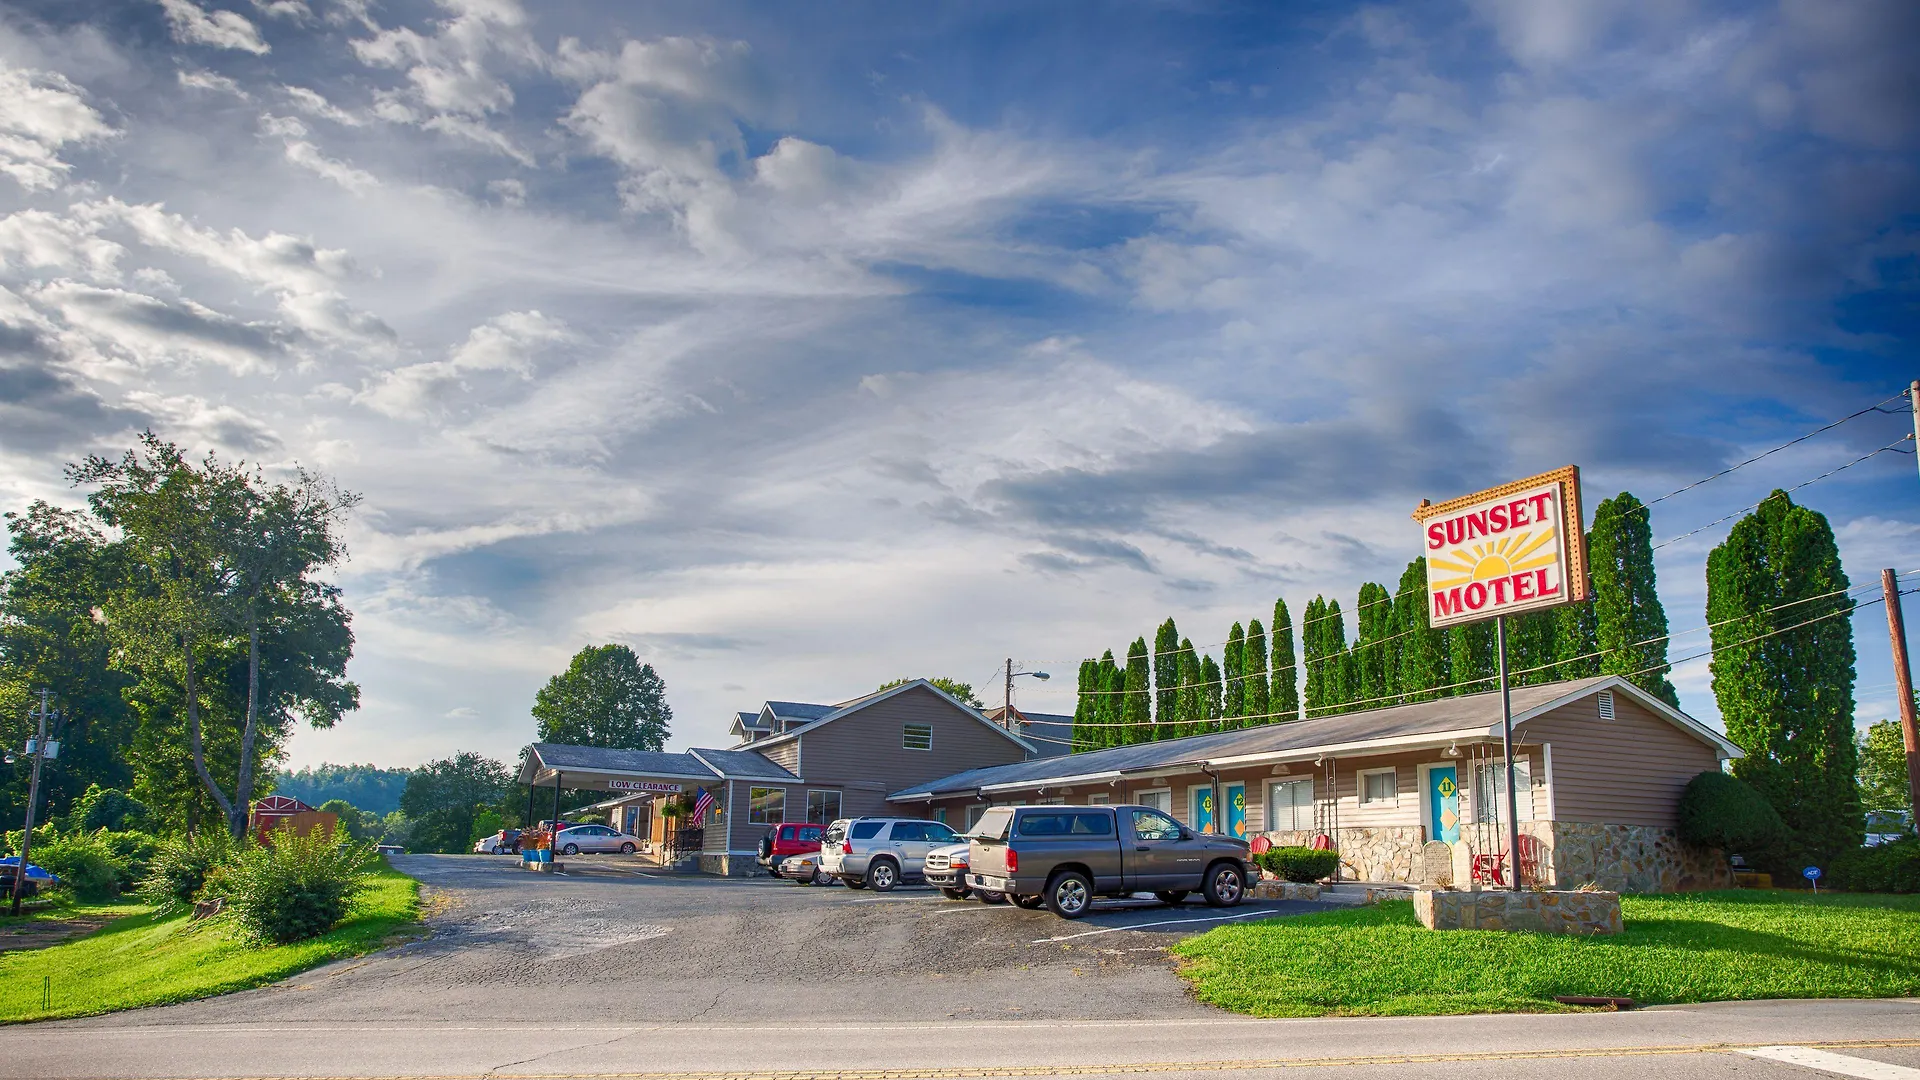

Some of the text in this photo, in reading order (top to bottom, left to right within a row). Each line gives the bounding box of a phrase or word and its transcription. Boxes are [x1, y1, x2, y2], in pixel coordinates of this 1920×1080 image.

[1427, 491, 1553, 550] SUNSET
[1433, 567, 1559, 618] MOTEL
[611, 780, 679, 792] LOW CLEARANCE
[1442, 781, 1451, 792] 11
